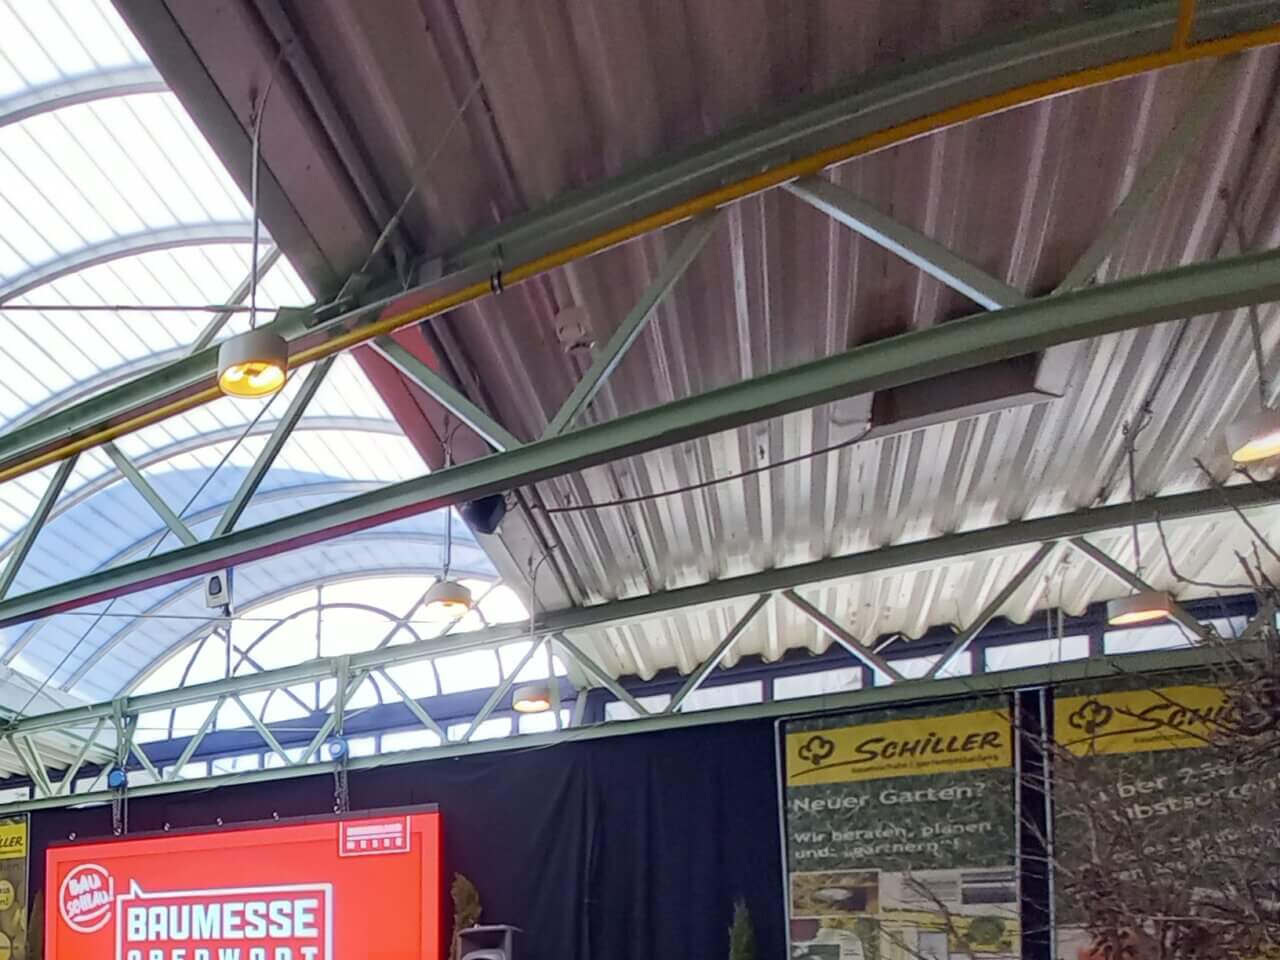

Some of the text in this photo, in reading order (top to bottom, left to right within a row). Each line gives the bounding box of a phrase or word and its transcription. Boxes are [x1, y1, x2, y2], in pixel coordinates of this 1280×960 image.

[793, 783, 986, 812] Neuer Garten?
[921, 820, 992, 838] planen
[127, 899, 319, 942] BAUMESSE
